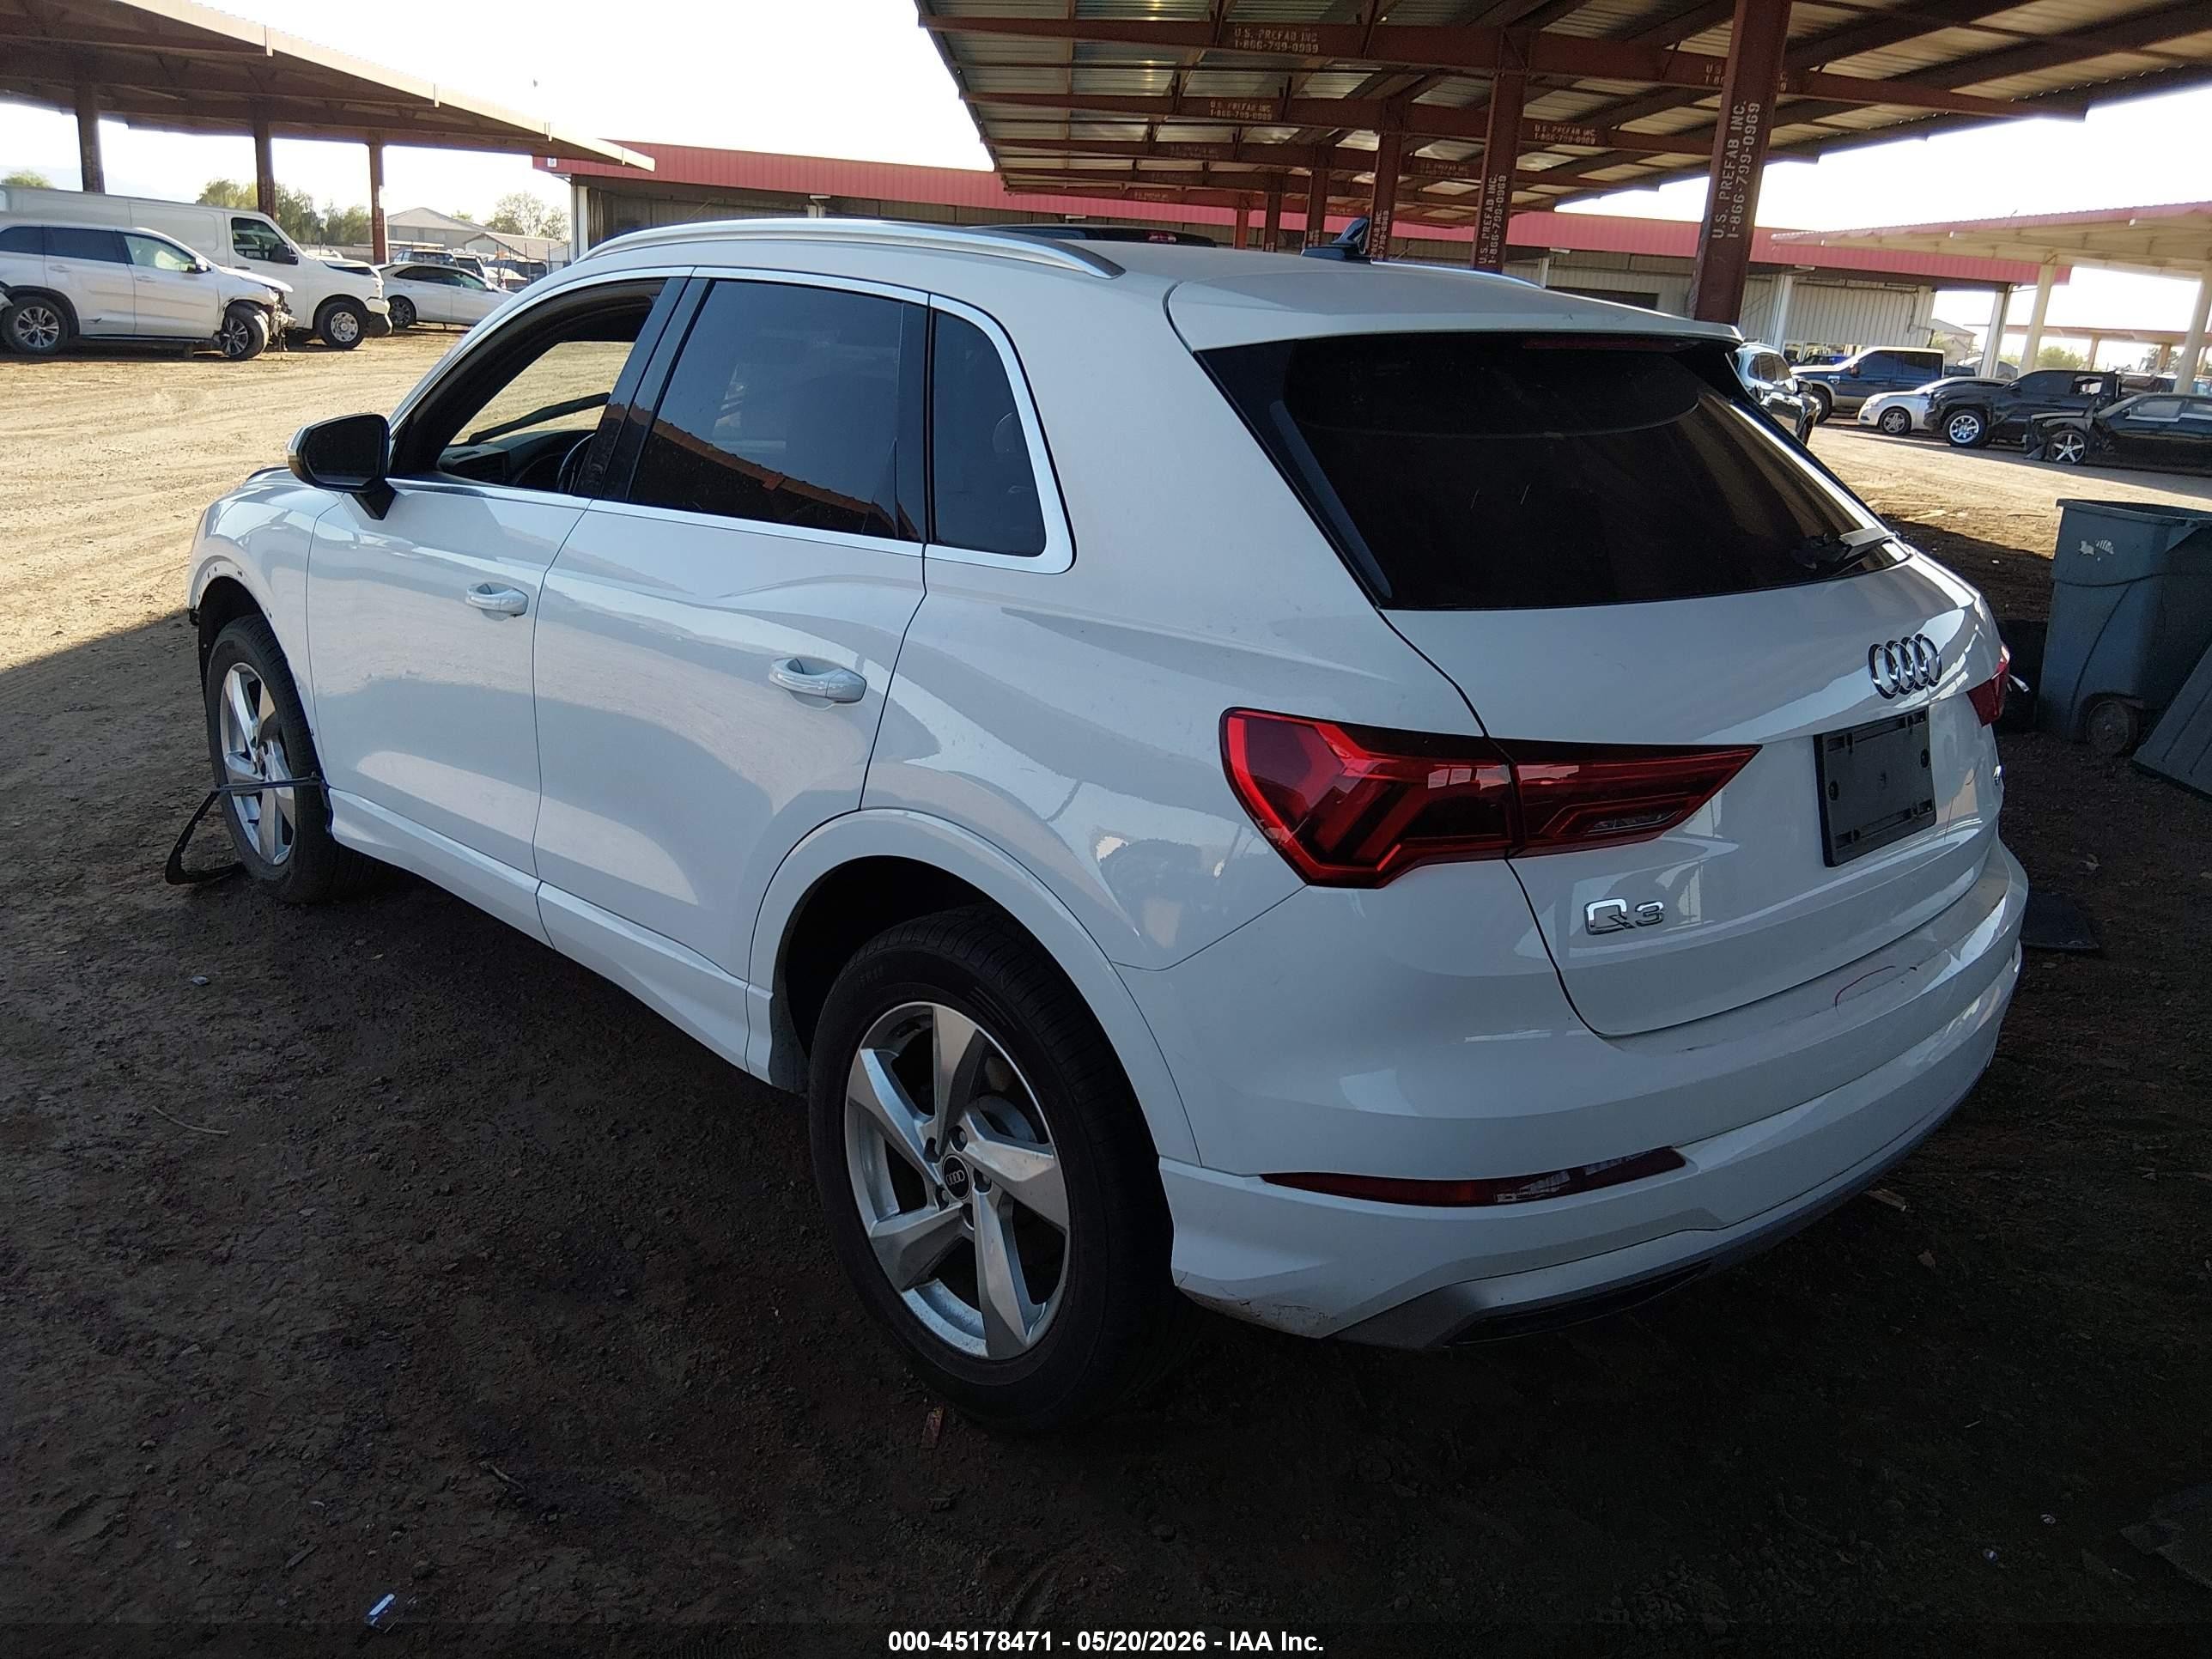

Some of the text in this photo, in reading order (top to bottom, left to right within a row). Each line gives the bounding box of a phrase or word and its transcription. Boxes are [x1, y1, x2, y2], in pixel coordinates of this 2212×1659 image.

[1711, 100, 1747, 239] U.S. PREFAB INC.
[1727, 102, 1760, 239] 1-866-799-0969
[1481, 198, 1495, 240] PREFAB
[1487, 174, 1507, 264] 1-866-799-0969
[1584, 898, 1663, 935] Q3
